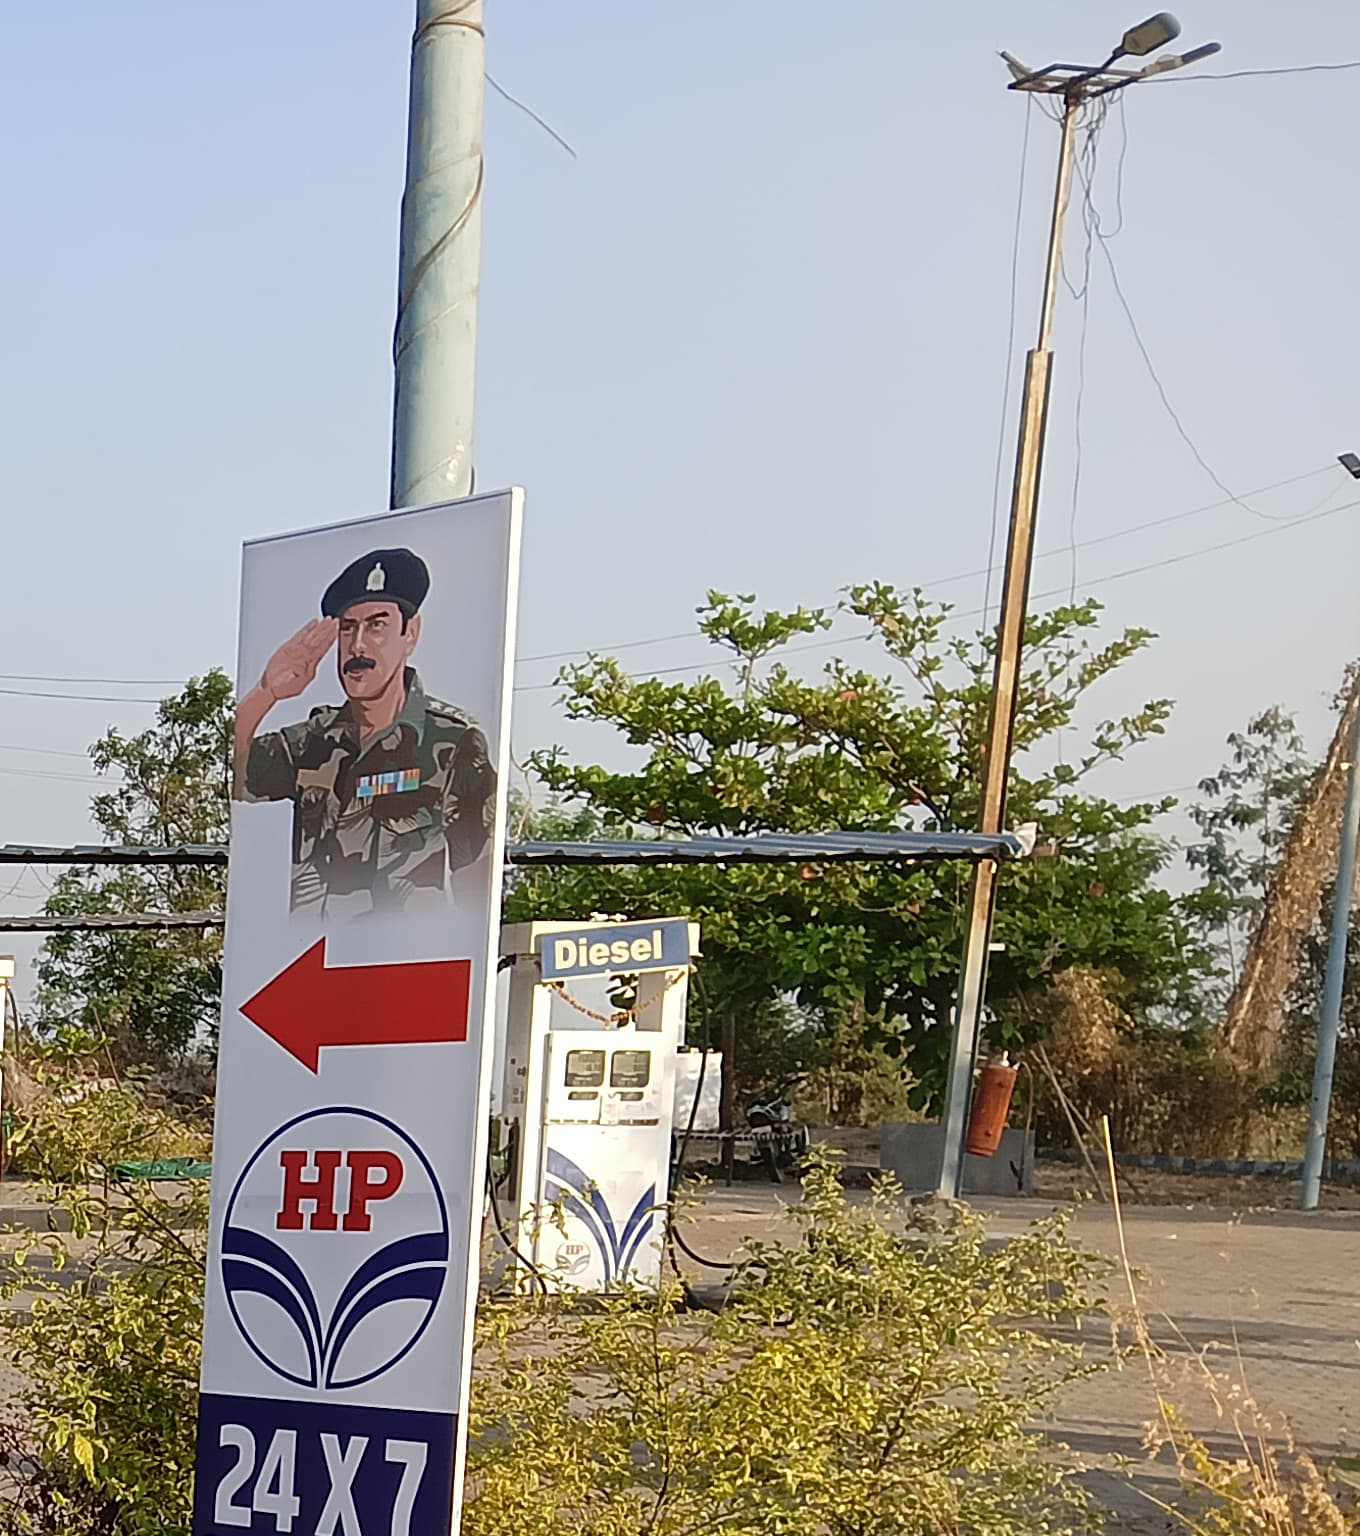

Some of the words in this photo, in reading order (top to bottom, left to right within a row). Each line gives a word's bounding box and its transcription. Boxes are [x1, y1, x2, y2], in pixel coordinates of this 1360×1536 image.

[554, 929, 662, 970] Diesel
[276, 1150, 404, 1232] HP
[565, 1245, 584, 1255] HP
[214, 1423, 300, 1533] 24
